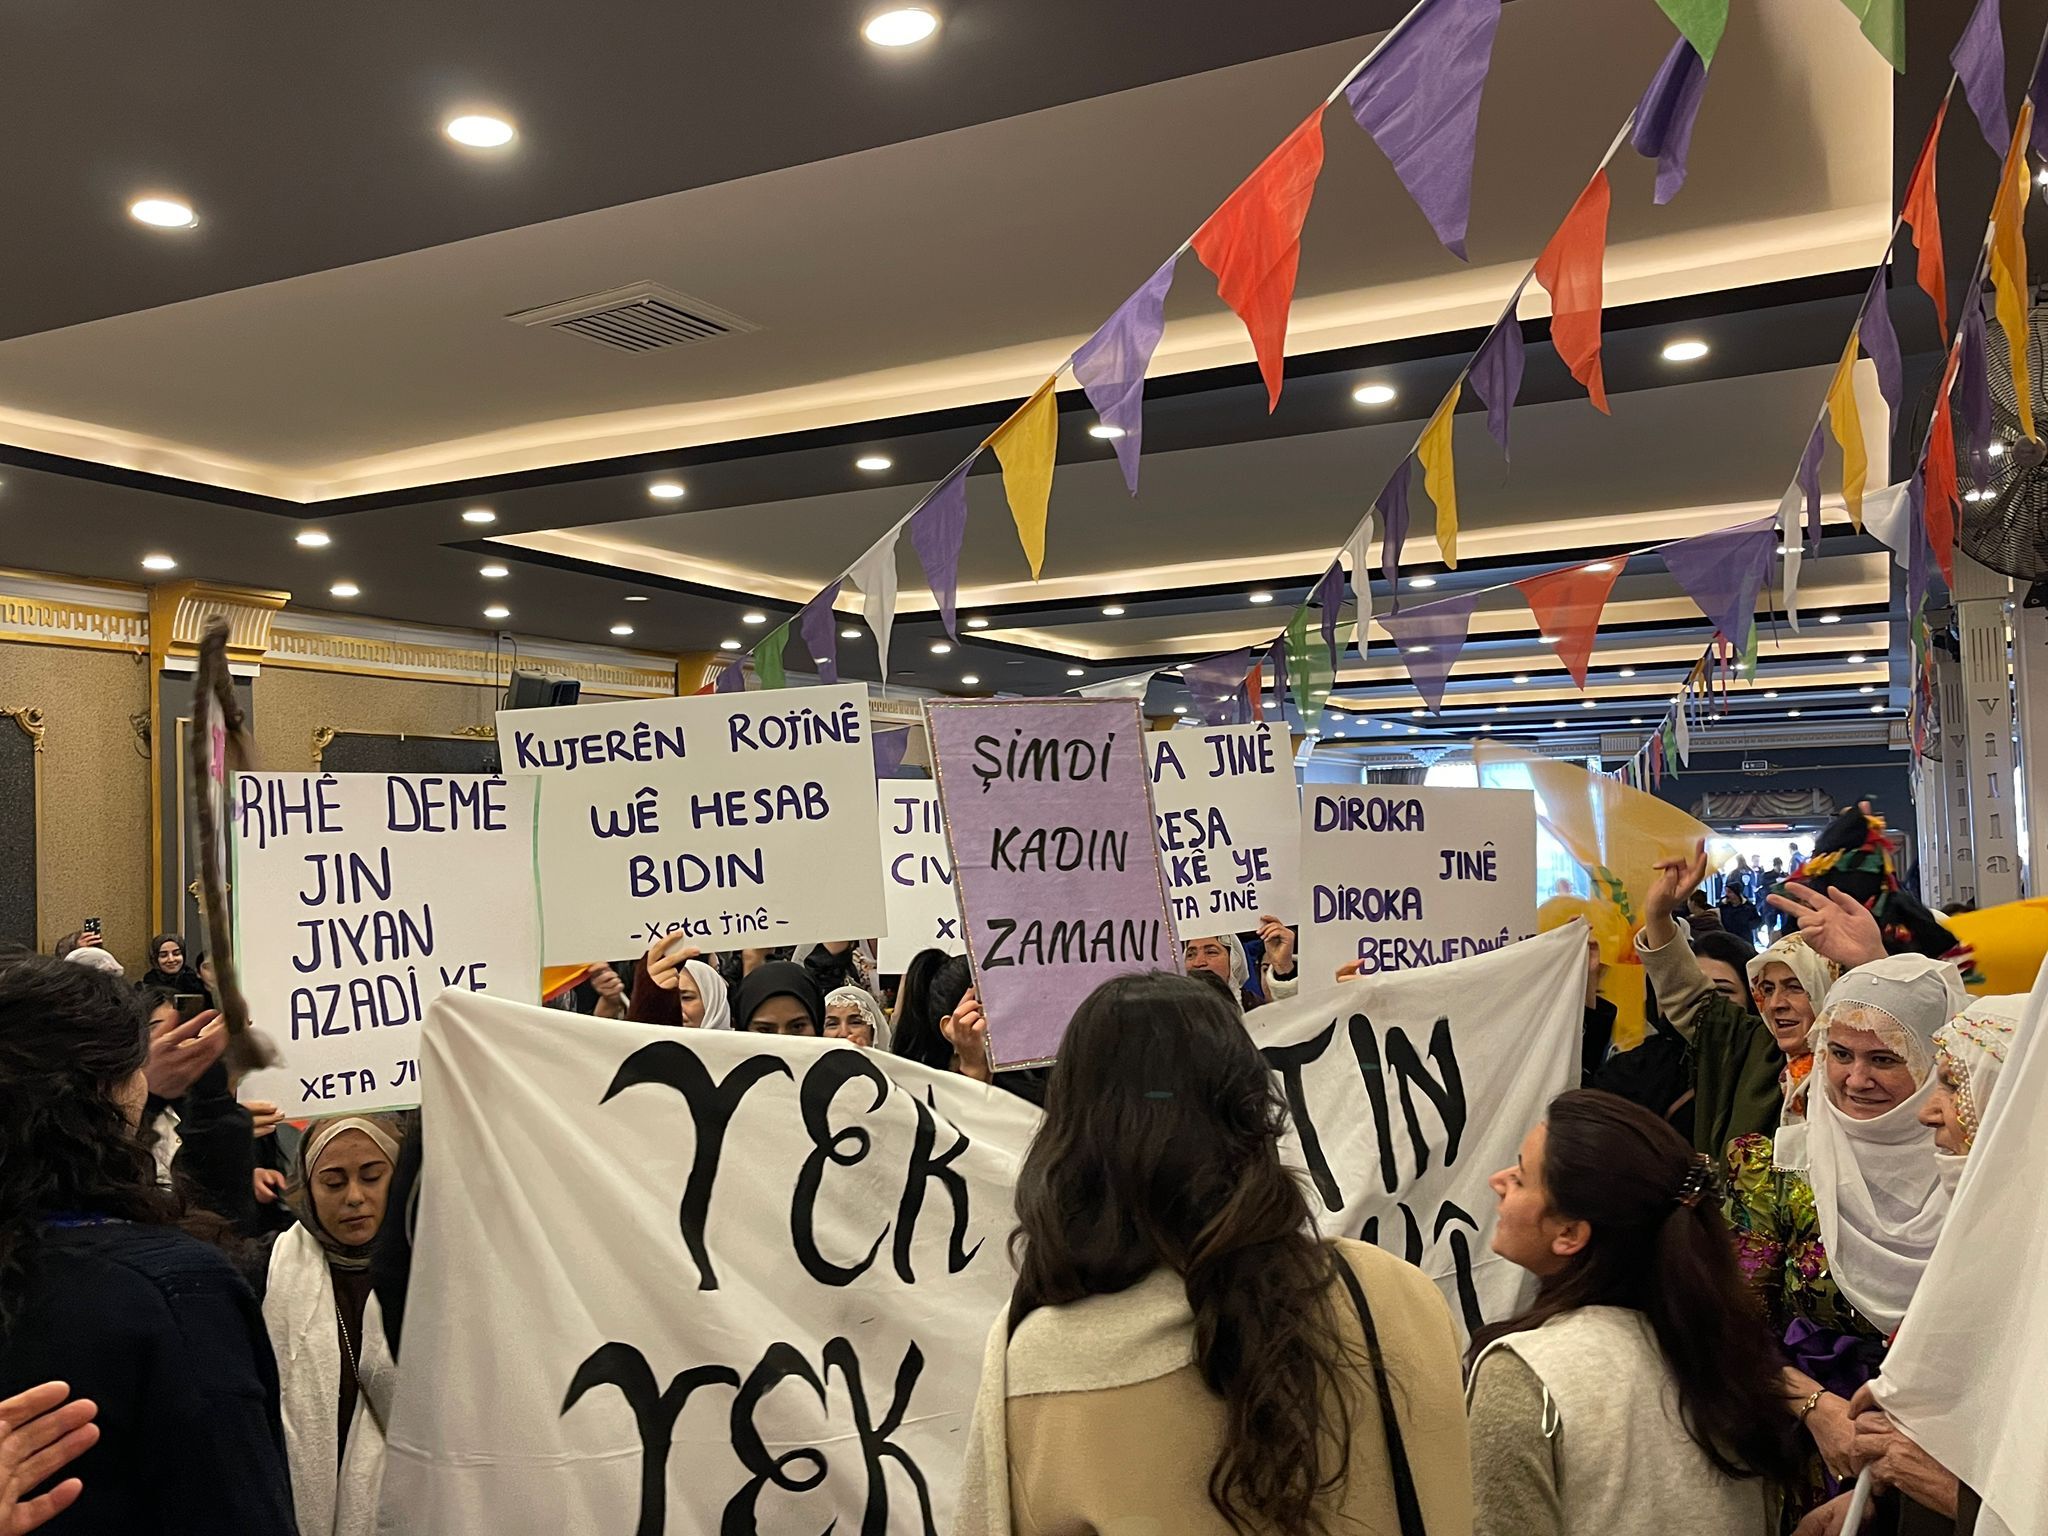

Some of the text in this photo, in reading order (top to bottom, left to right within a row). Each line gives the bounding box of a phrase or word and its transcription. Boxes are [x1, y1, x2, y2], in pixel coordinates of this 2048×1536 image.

[514, 702, 860, 770] KUJERÊN ROJÎNÊ
[972, 728, 1116, 793] ŞİMDİ
[1204, 723, 1275, 777] JINÊ
[239, 773, 508, 849] RIHÊ DEMÊ
[590, 781, 830, 838] WÊ HESAB
[1314, 794, 1425, 832] DÎROKA
[629, 848, 764, 897] BIDIN
[990, 826, 1128, 873] KADIN
[1233, 847, 1272, 884] YE
[1439, 841, 1497, 882] JINÊ
[299, 847, 391, 906] JIN
[1210, 882, 1258, 913] JINÊ
[1313, 883, 1423, 924] DÎROKA
[292, 904, 433, 973] JIYAN
[981, 918, 1159, 971] ZAMANI
[291, 966, 422, 1041] AZADÎ
[300, 1059, 421, 1102] XETA JI
[599, 1040, 985, 1291] YEK
